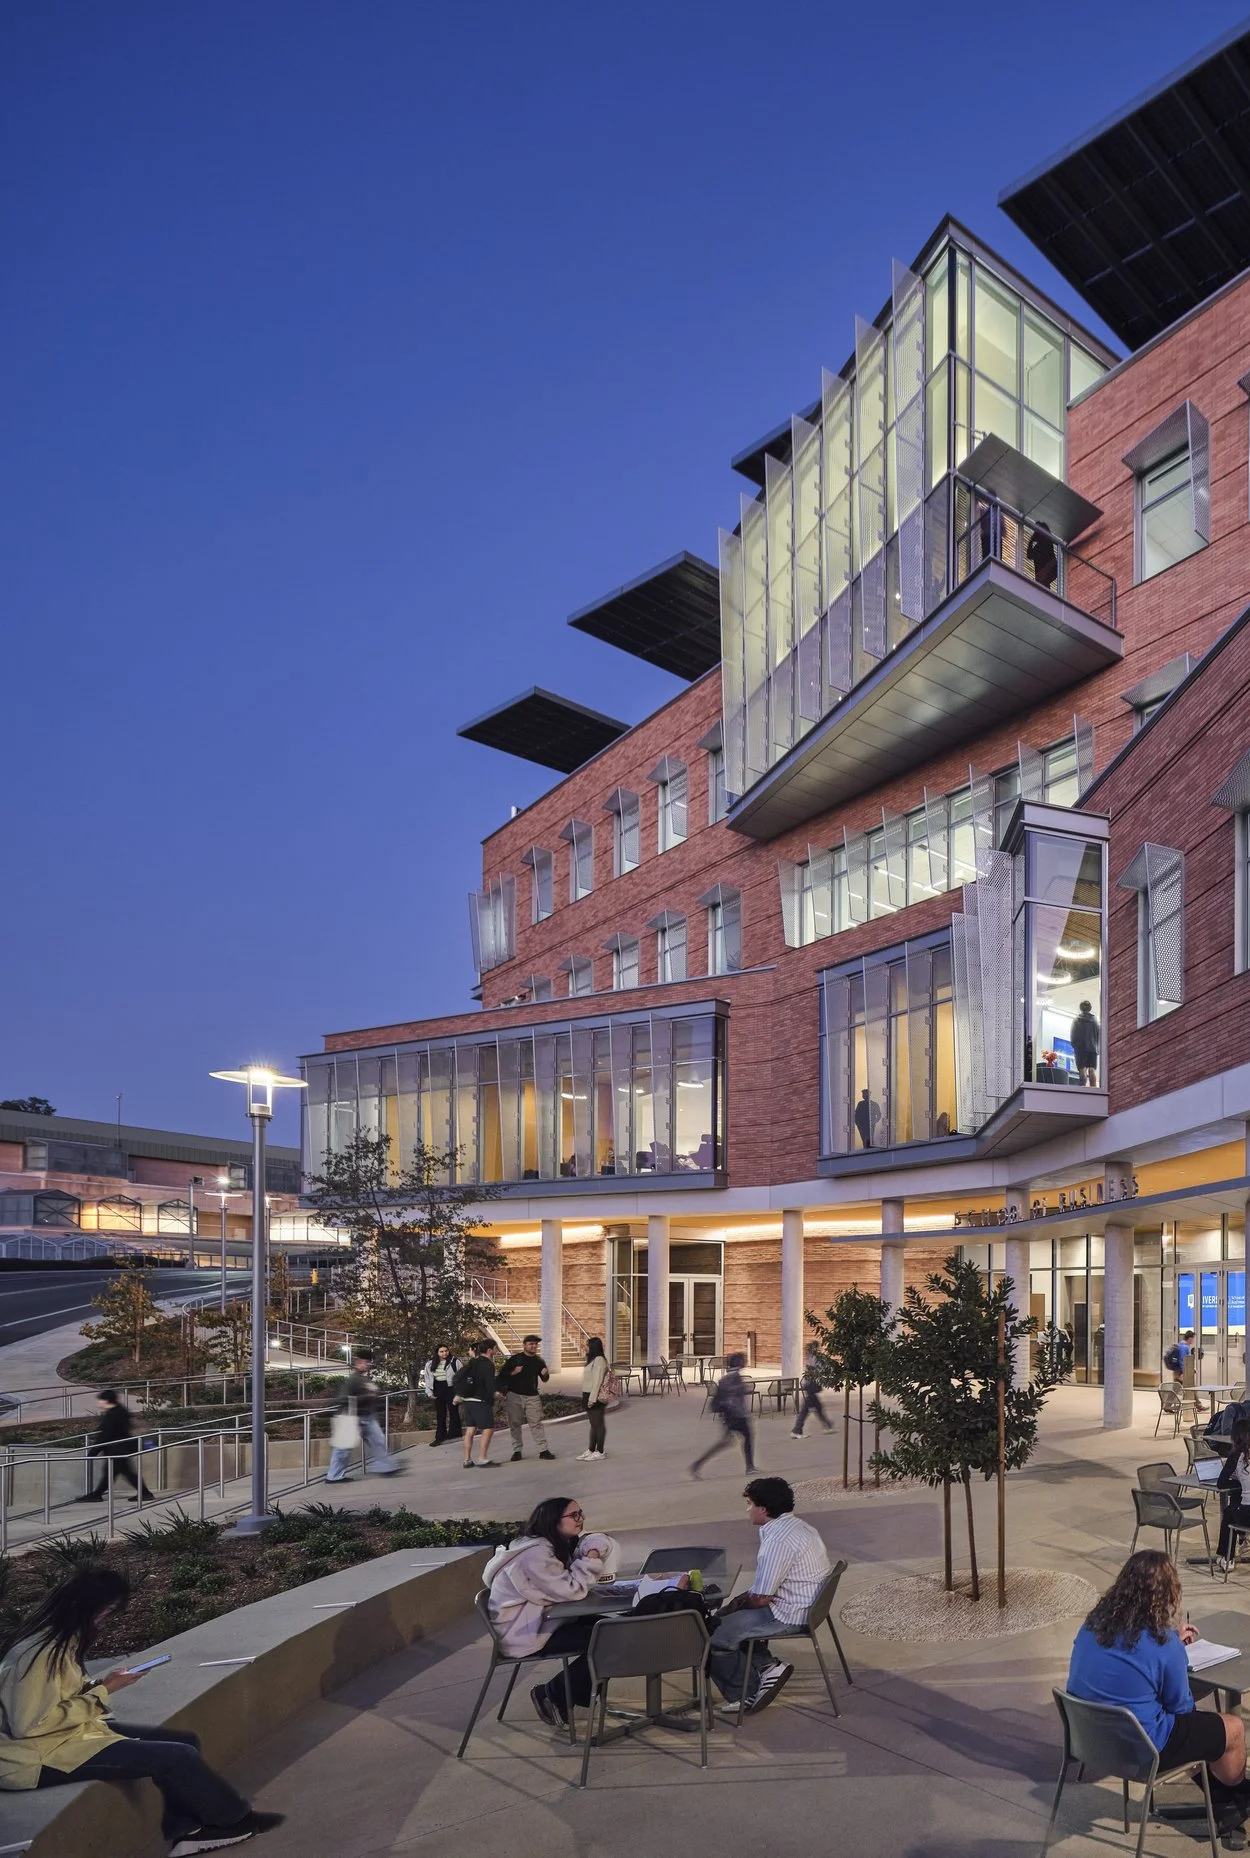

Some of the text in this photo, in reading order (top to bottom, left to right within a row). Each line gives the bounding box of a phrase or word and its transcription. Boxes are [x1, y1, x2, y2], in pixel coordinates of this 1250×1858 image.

[954, 1174, 1139, 1226] SCHOOL OF BUSINESS
